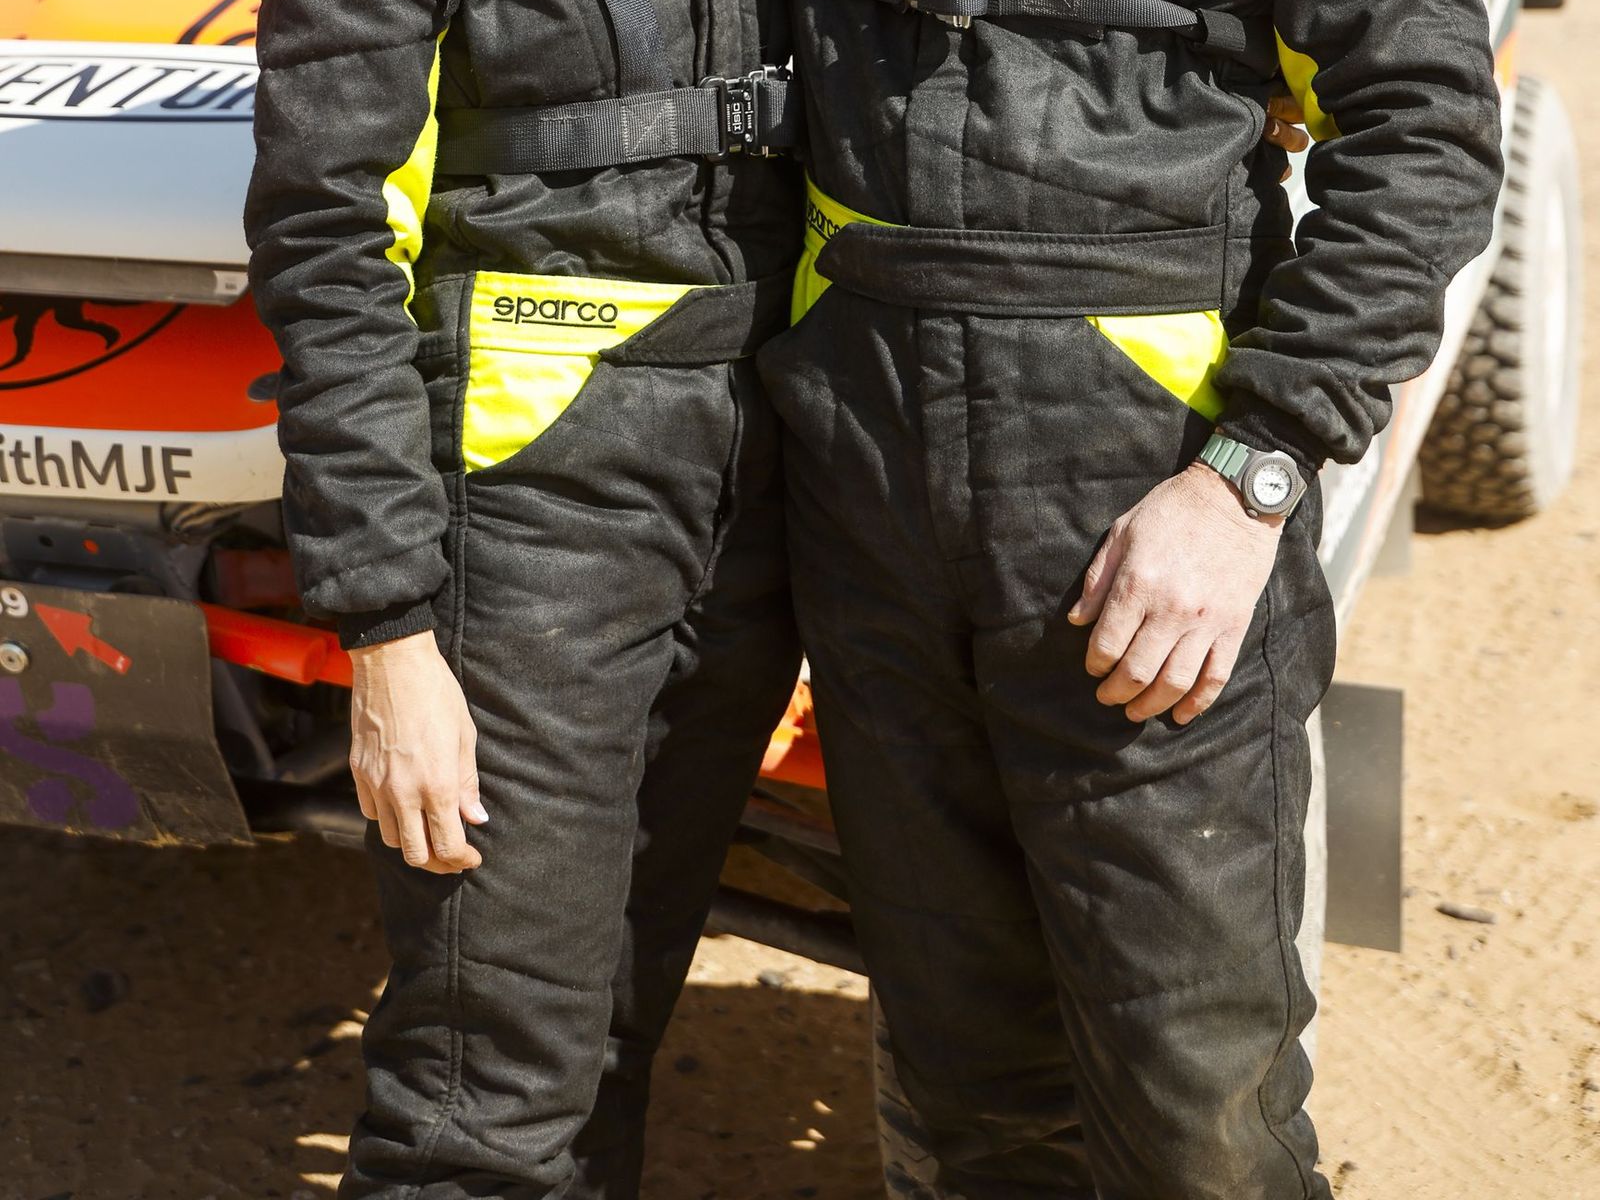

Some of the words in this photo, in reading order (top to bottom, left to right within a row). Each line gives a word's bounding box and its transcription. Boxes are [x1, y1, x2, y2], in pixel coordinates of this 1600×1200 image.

[0, 62, 256, 110] ENTU
[493, 296, 618, 326] sparco
[0, 586, 29, 618] 9
